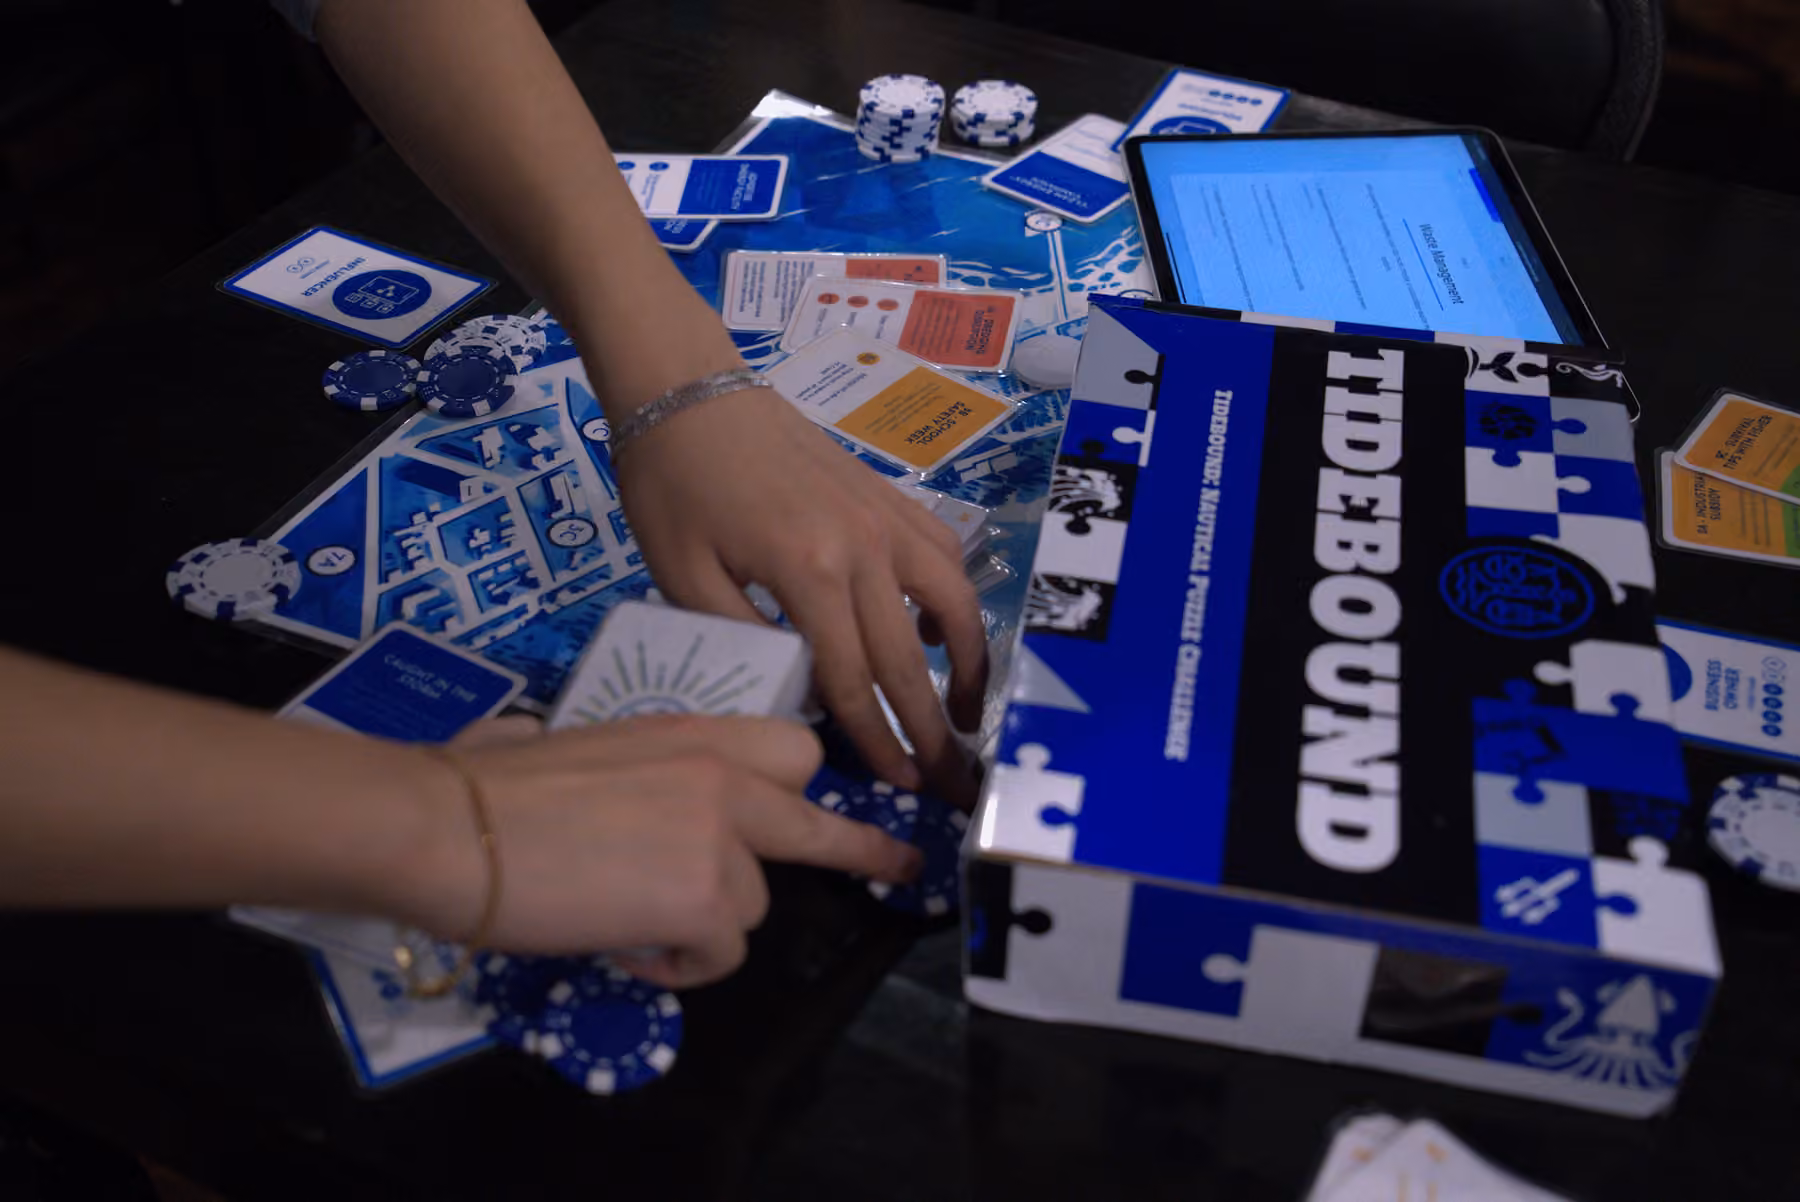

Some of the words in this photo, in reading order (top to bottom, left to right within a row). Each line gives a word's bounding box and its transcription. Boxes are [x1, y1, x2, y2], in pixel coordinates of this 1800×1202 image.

[303, 257, 366, 297] INFLUENCER
[1420, 224, 1438, 249] Waste
[1431, 249, 1464, 304] Management
[904, 426, 935, 445] WEEK
[916, 419, 957, 445] SCHOOL
[932, 401, 965, 426] SAFETY
[1201, 389, 1234, 486] TIDEBOUND:
[1189, 486, 1221, 572] NAUTICAL
[1295, 349, 1405, 874] TIDEBOUND
